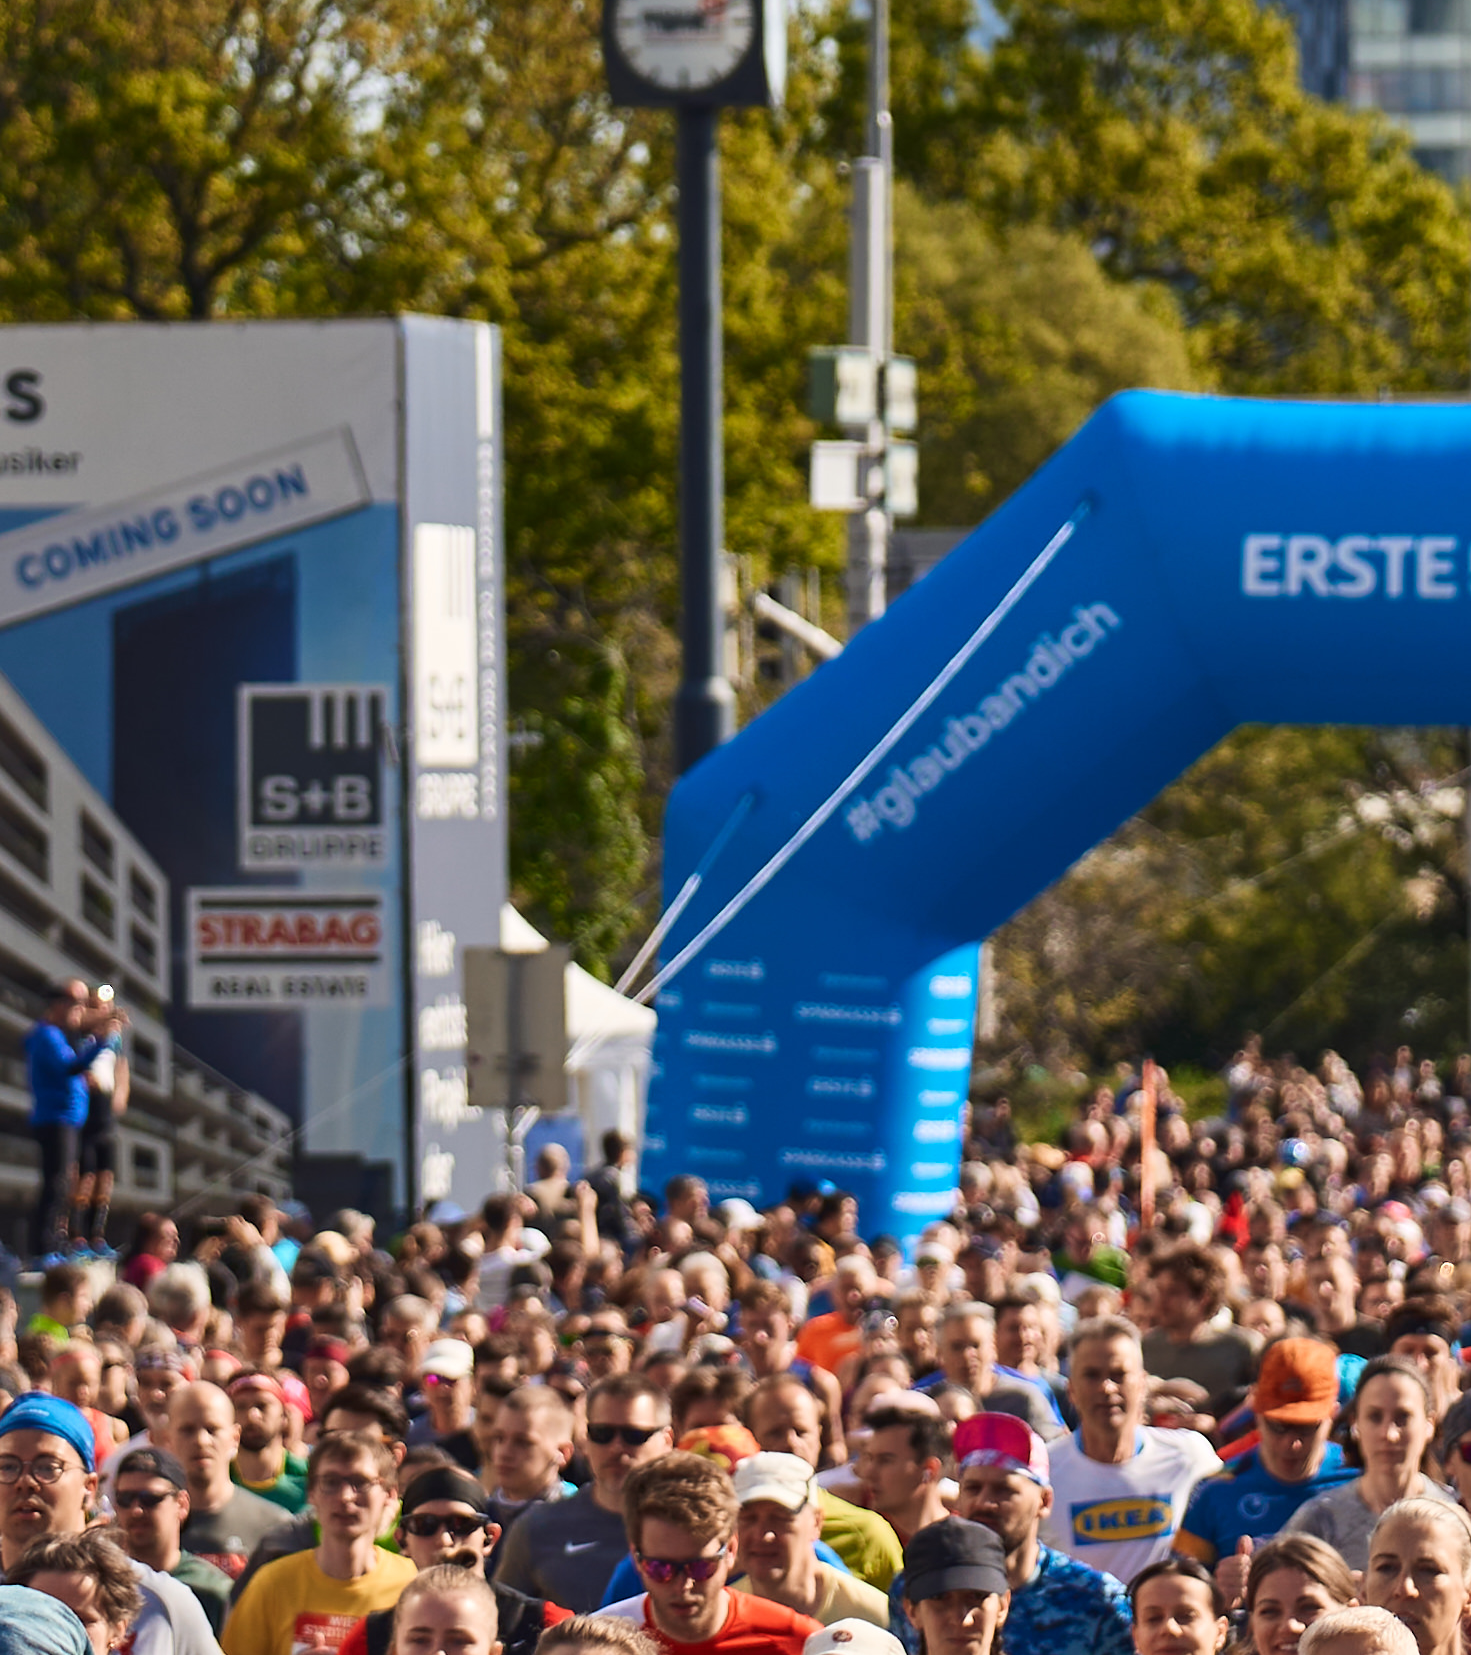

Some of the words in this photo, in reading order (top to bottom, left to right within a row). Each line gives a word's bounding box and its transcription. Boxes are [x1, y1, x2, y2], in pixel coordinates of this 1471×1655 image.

[14, 510, 180, 589] COMING
[185, 463, 310, 531] SOON
[1242, 533, 1457, 600] ERSTE
[843, 600, 1123, 843] #glaubandich
[259, 774, 373, 822] S+B
[197, 911, 381, 949] STRABAG
[1083, 1506, 1166, 1532] IKEA
